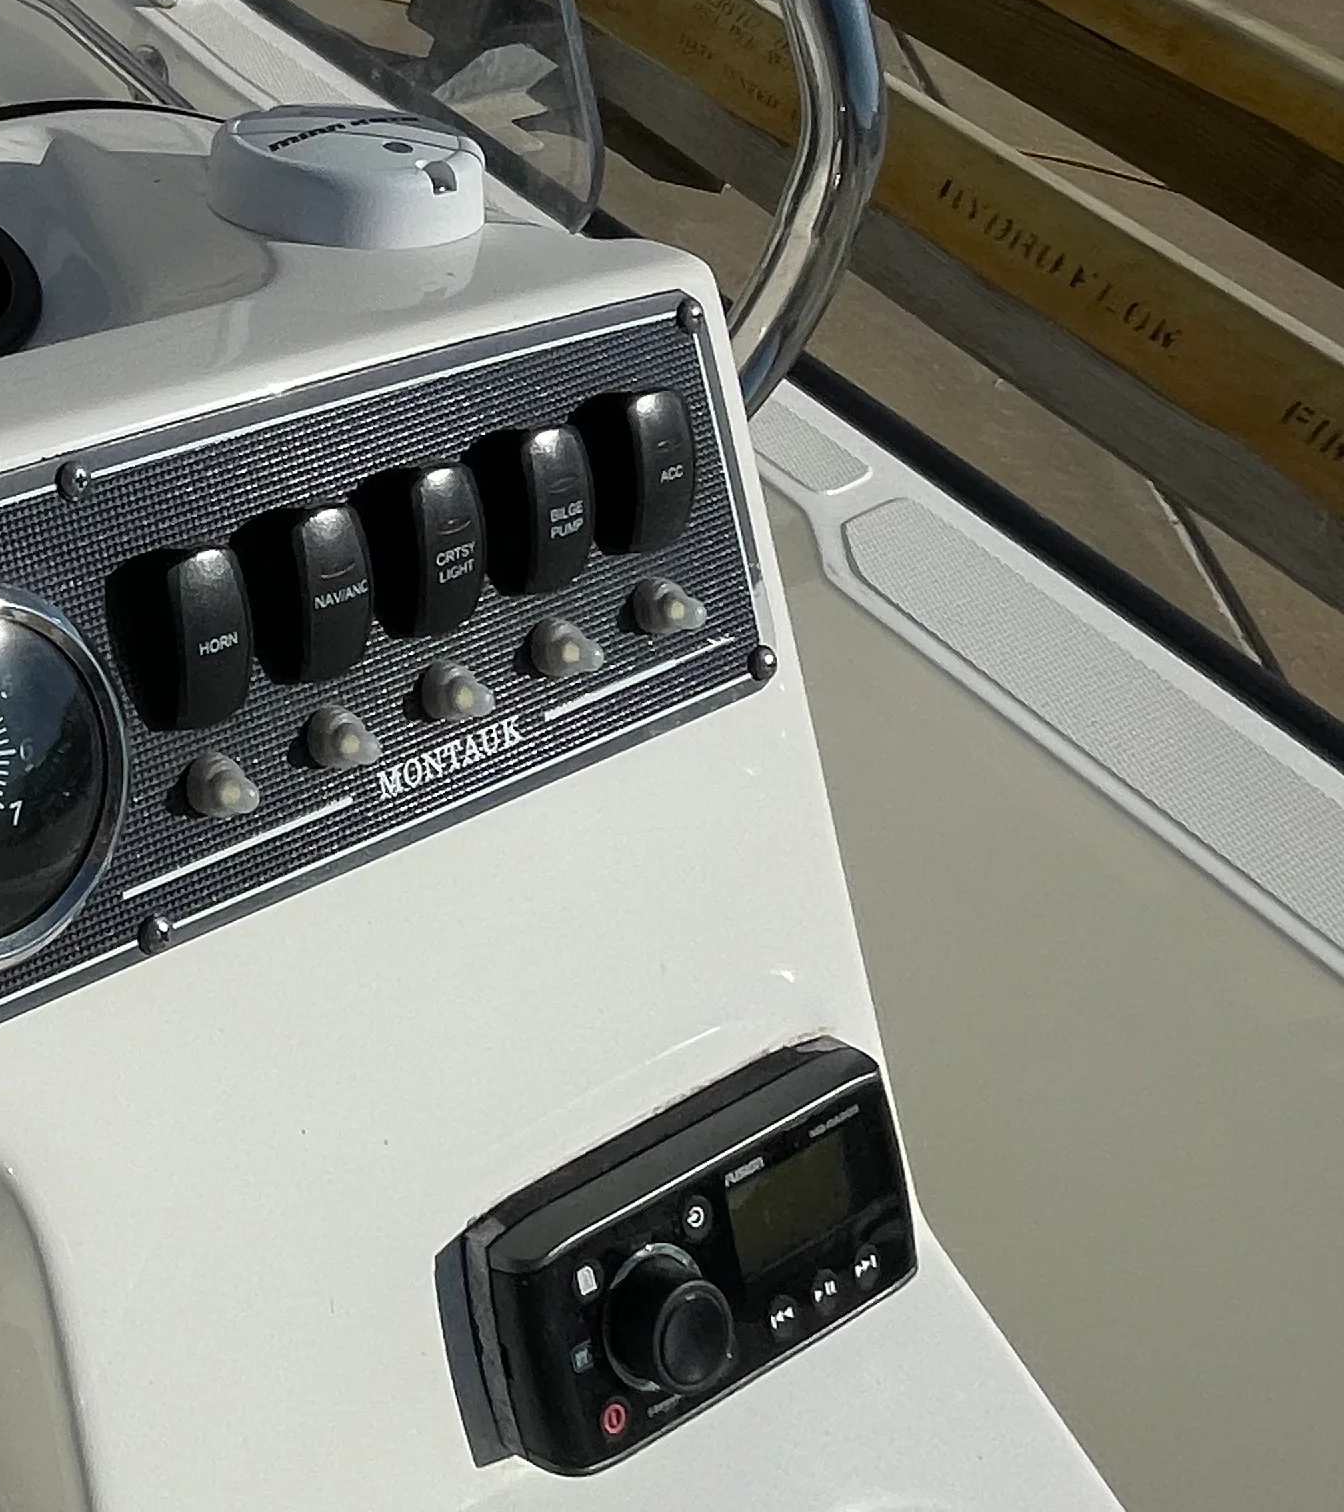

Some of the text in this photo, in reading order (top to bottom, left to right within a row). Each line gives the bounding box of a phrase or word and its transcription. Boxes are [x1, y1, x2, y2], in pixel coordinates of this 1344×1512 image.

[660, 464, 685, 484] ACC
[550, 500, 585, 522] BILGE
[550, 517, 585, 540] PUMP
[436, 541, 477, 567] CRTSY
[438, 558, 476, 584] LIGHT
[314, 579, 369, 610] NAV/ANC
[199, 631, 239, 656] HORN
[375, 713, 525, 801] MONTAUK
[9, 799, 24, 827] 7
